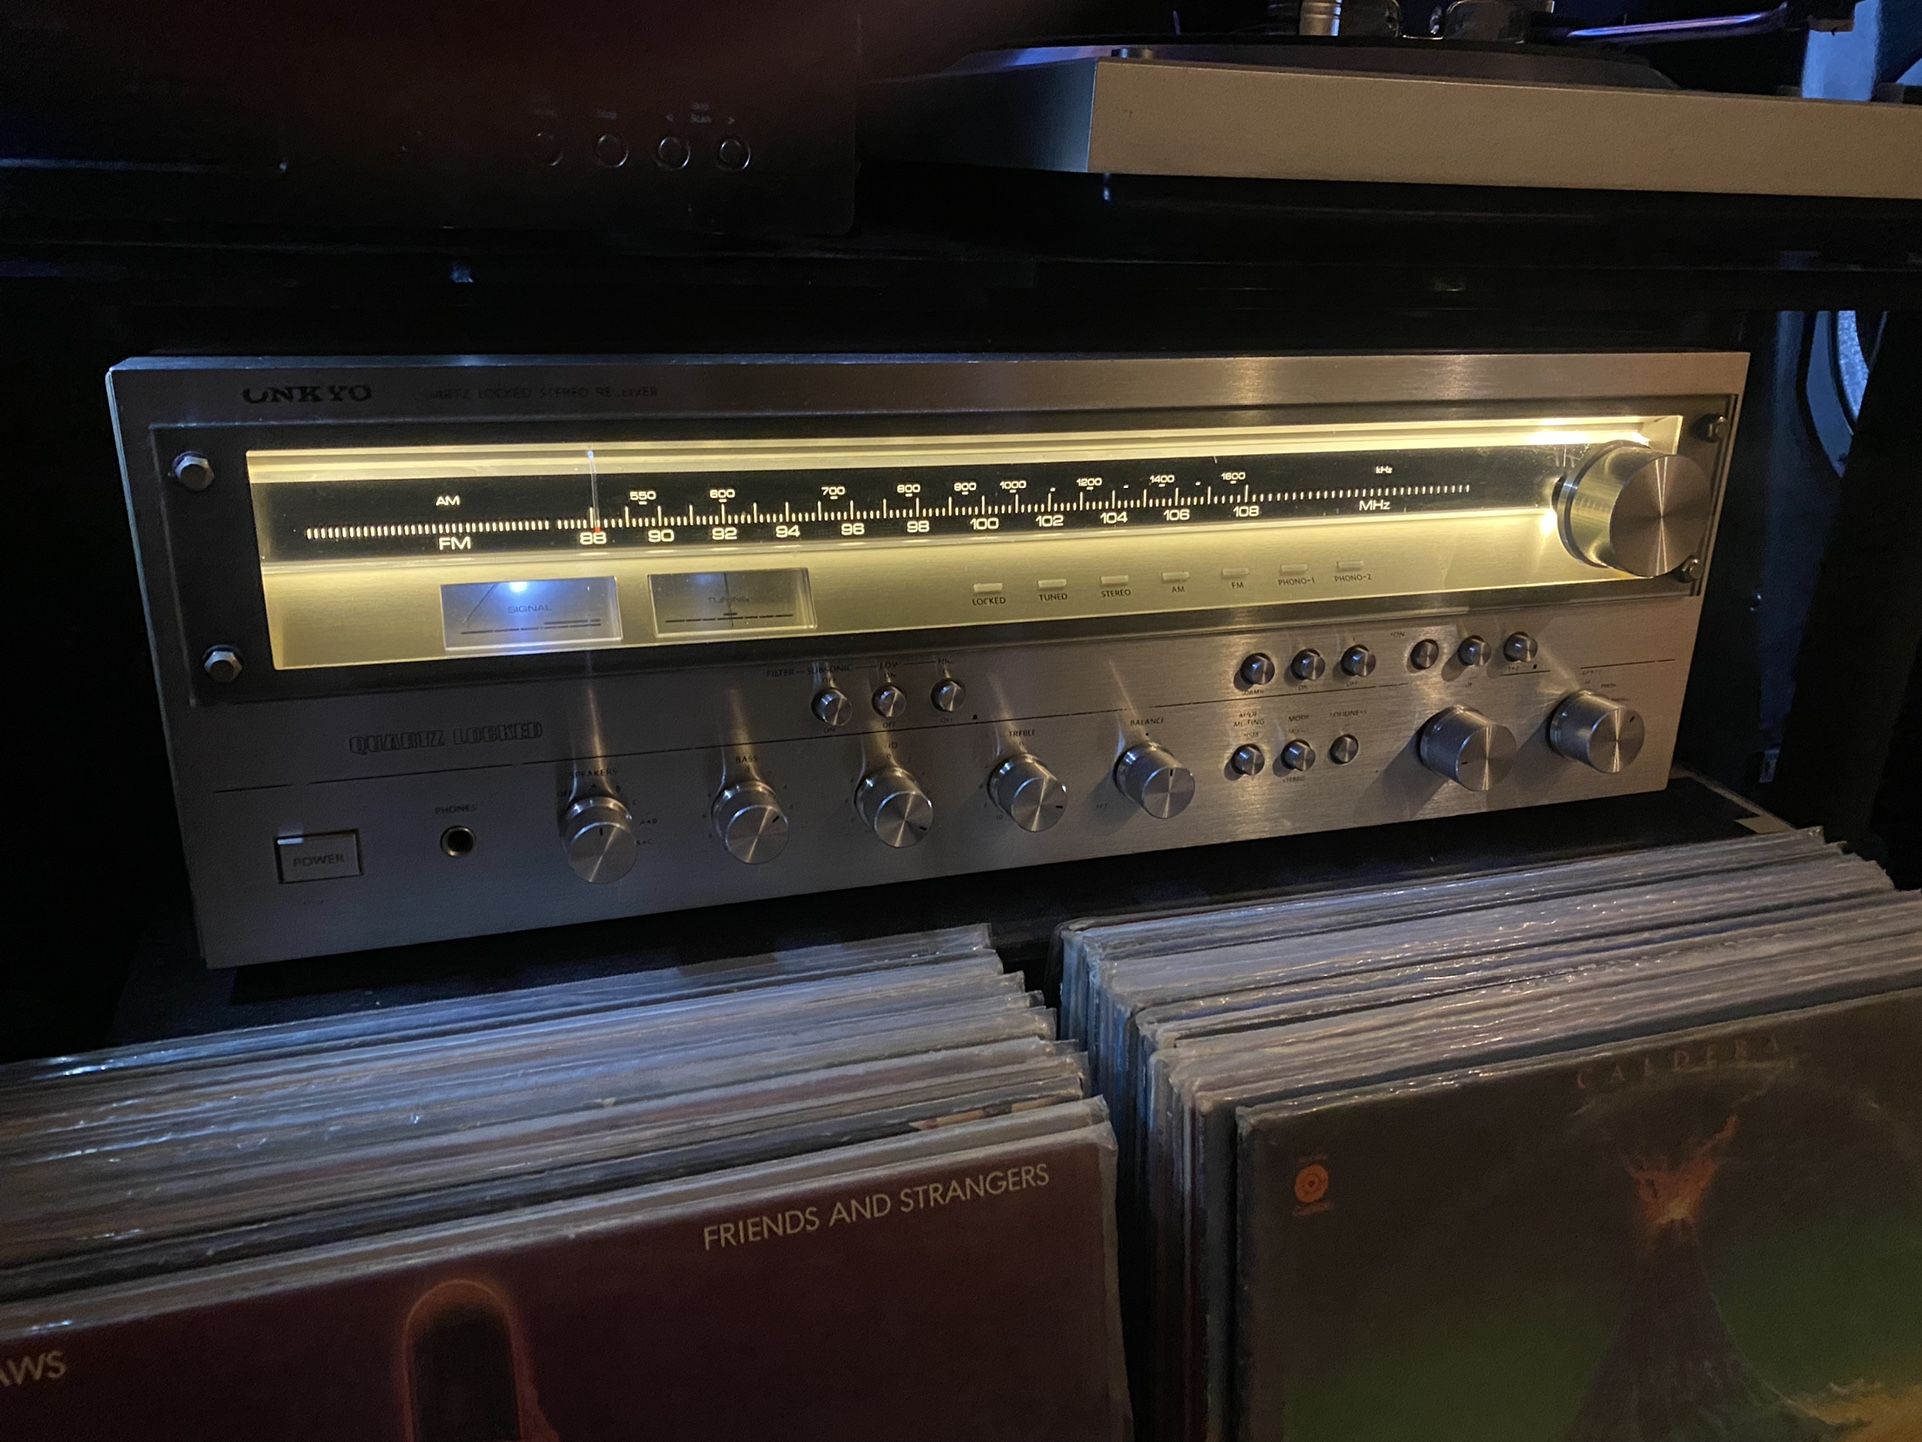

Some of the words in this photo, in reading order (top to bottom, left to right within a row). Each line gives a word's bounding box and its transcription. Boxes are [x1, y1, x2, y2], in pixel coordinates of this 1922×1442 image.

[242, 384, 372, 404] ONKYO
[595, 385, 658, 397] REEIVER
[436, 495, 461, 507] AM
[630, 490, 656, 501] 550
[709, 488, 735, 499] 600
[821, 486, 846, 496] 700
[897, 484, 920, 494] 800
[999, 480, 1027, 490] 1000
[1076, 477, 1102, 487] 1200
[1150, 474, 1175, 484] 1400
[1221, 471, 1245, 481] 1600
[1375, 465, 1392, 475] kHz
[439, 536, 471, 551] FM
[579, 530, 607, 545] 88
[648, 528, 675, 543] 90
[712, 526, 738, 541] 92
[775, 524, 801, 538] 94
[841, 522, 865, 536] 96
[906, 520, 930, 533] 98
[969, 517, 999, 530] 100
[1035, 514, 1064, 527] 102
[1099, 511, 1128, 524] 104
[1163, 508, 1190, 521] 106
[1232, 505, 1259, 518] 108
[1359, 499, 1391, 511] MHz
[1278, 576, 1316, 586] PHONO-1
[1101, 588, 1132, 598] STEREO
[1171, 585, 1185, 593] AM
[972, 596, 1006, 606] LOCKED
[1039, 592, 1068, 601] TUNED
[507, 604, 553, 614] SIGNAL
[1130, 717, 1165, 727] BALANCE
[348, 730, 445, 755] QUARTZ
[452, 721, 544, 745] LOCKED
[735, 755, 758, 764] BASS
[434, 803, 478, 816] PHONES
[292, 853, 345, 868] POWER
[702, 1206, 821, 1252] FRIENDS
[828, 1193, 892, 1227] AND
[899, 1163, 1051, 1213] STRANGERS
